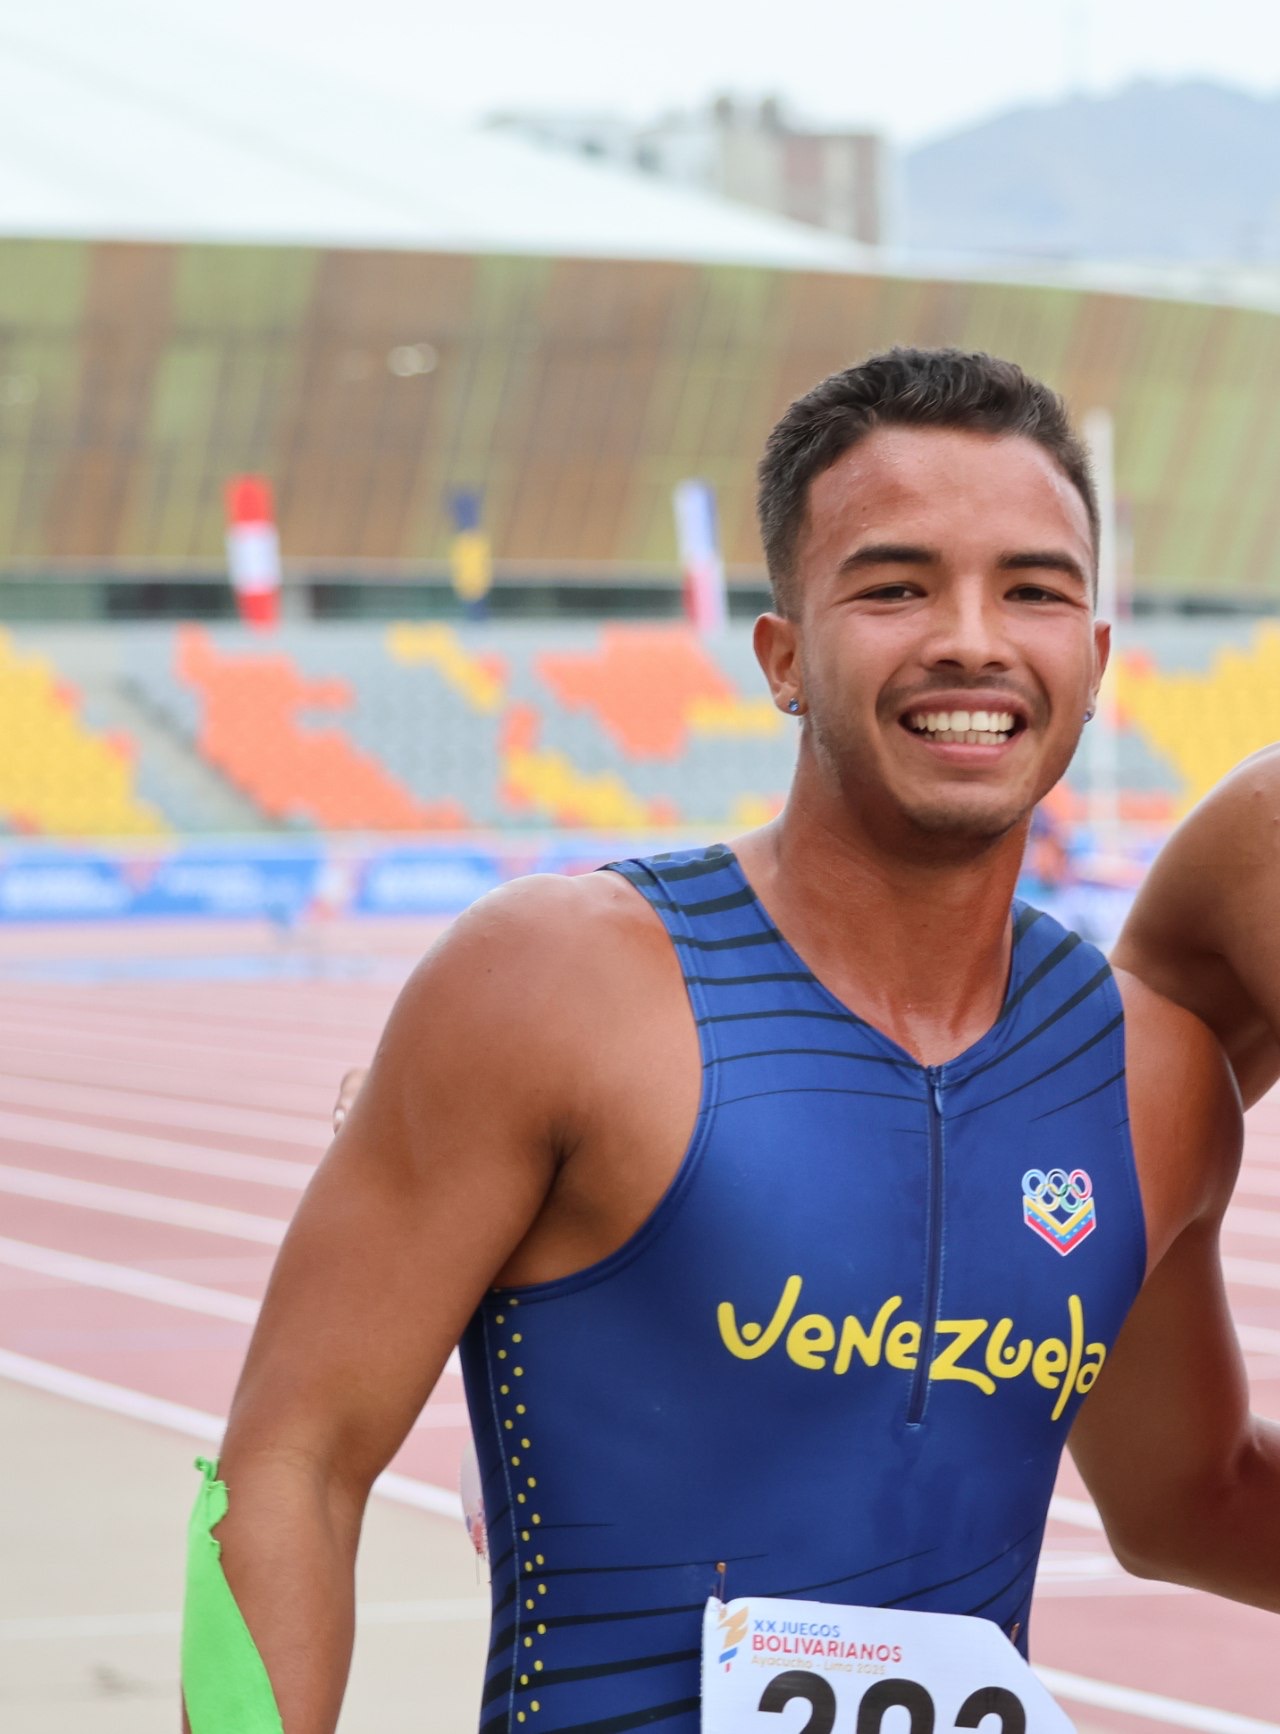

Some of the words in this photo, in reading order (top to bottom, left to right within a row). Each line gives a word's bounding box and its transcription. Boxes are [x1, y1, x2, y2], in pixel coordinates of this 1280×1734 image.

[754, 1620, 777, 1633] XX
[779, 1621, 841, 1638] JUEGOS
[752, 1634, 903, 1663] BOLIVARIANOS
